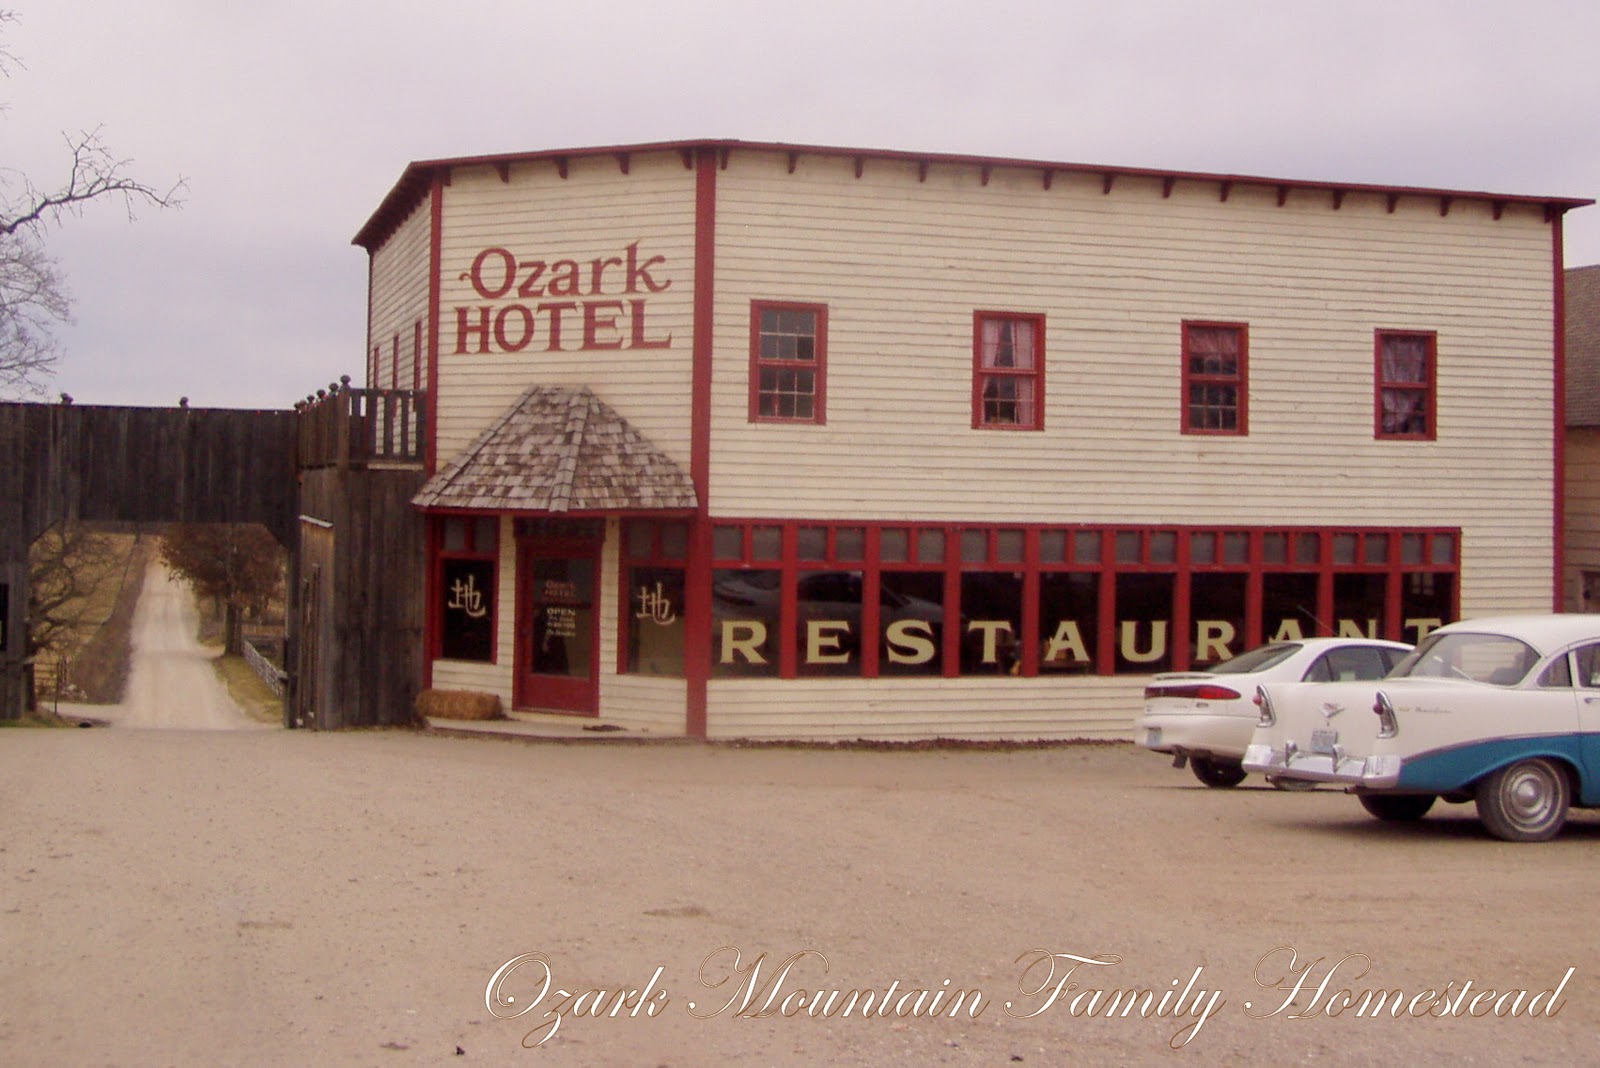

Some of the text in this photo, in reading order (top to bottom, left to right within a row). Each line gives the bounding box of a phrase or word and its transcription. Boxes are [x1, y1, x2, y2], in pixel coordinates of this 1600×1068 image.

[459, 239, 672, 299] Ozark
[454, 298, 672, 354] HOTEL
[546, 607, 576, 616] OPEN
